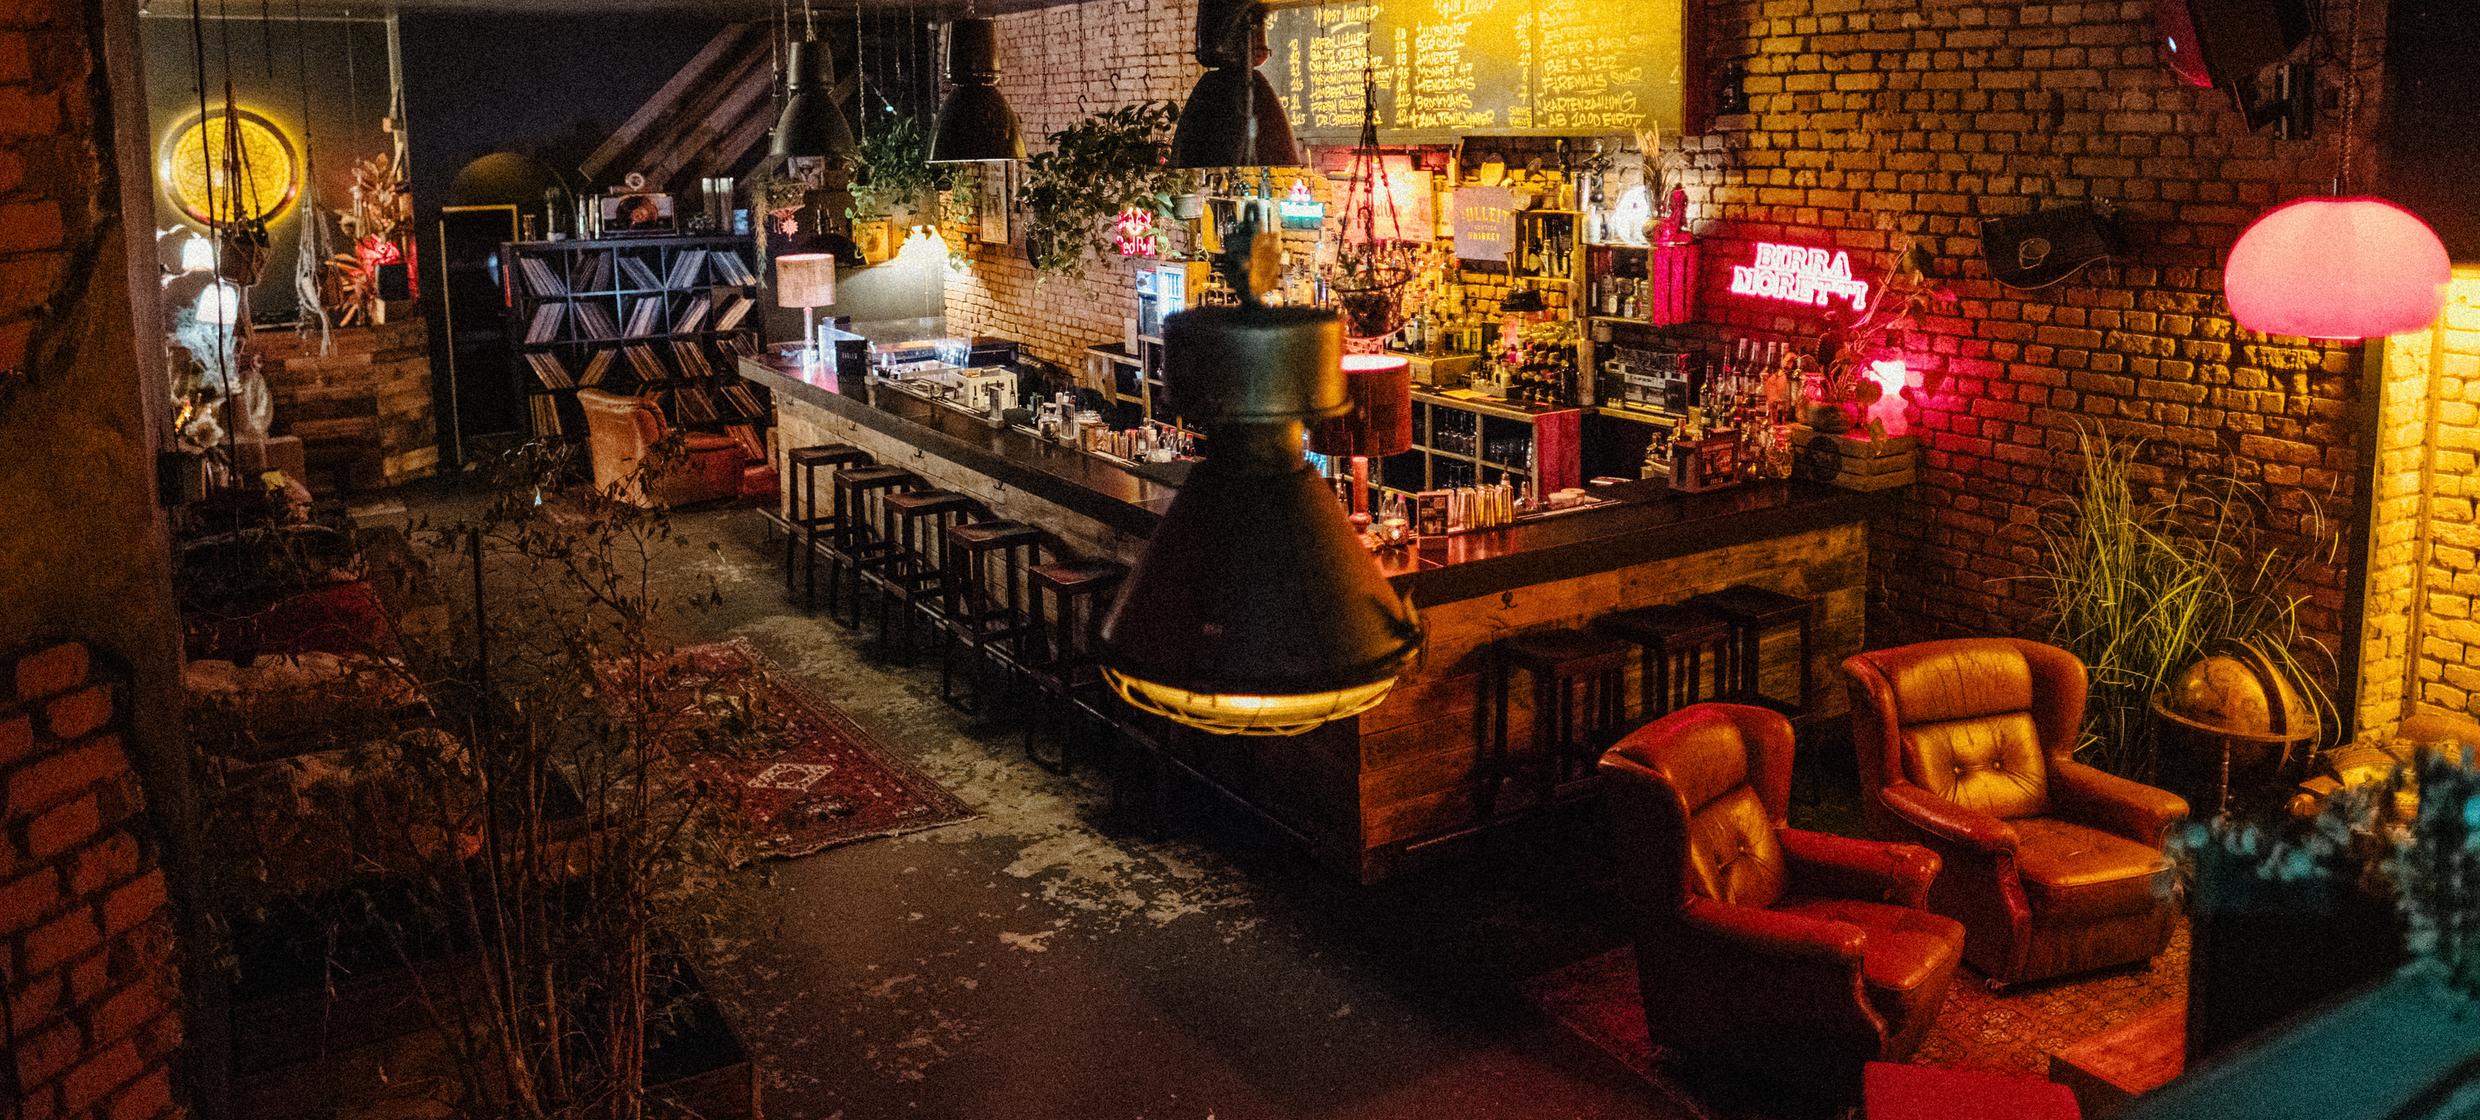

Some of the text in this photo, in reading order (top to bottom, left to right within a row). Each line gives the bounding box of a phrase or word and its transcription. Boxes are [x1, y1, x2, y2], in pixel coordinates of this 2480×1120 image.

[1414, 76, 1476, 94] HENDRICKS
[1543, 91, 1637, 113] KARTENZAHLUNG
[1548, 112, 1568, 129] AB
[1754, 242, 1853, 281] BIRRA
[1731, 265, 1869, 311] MORETTI
